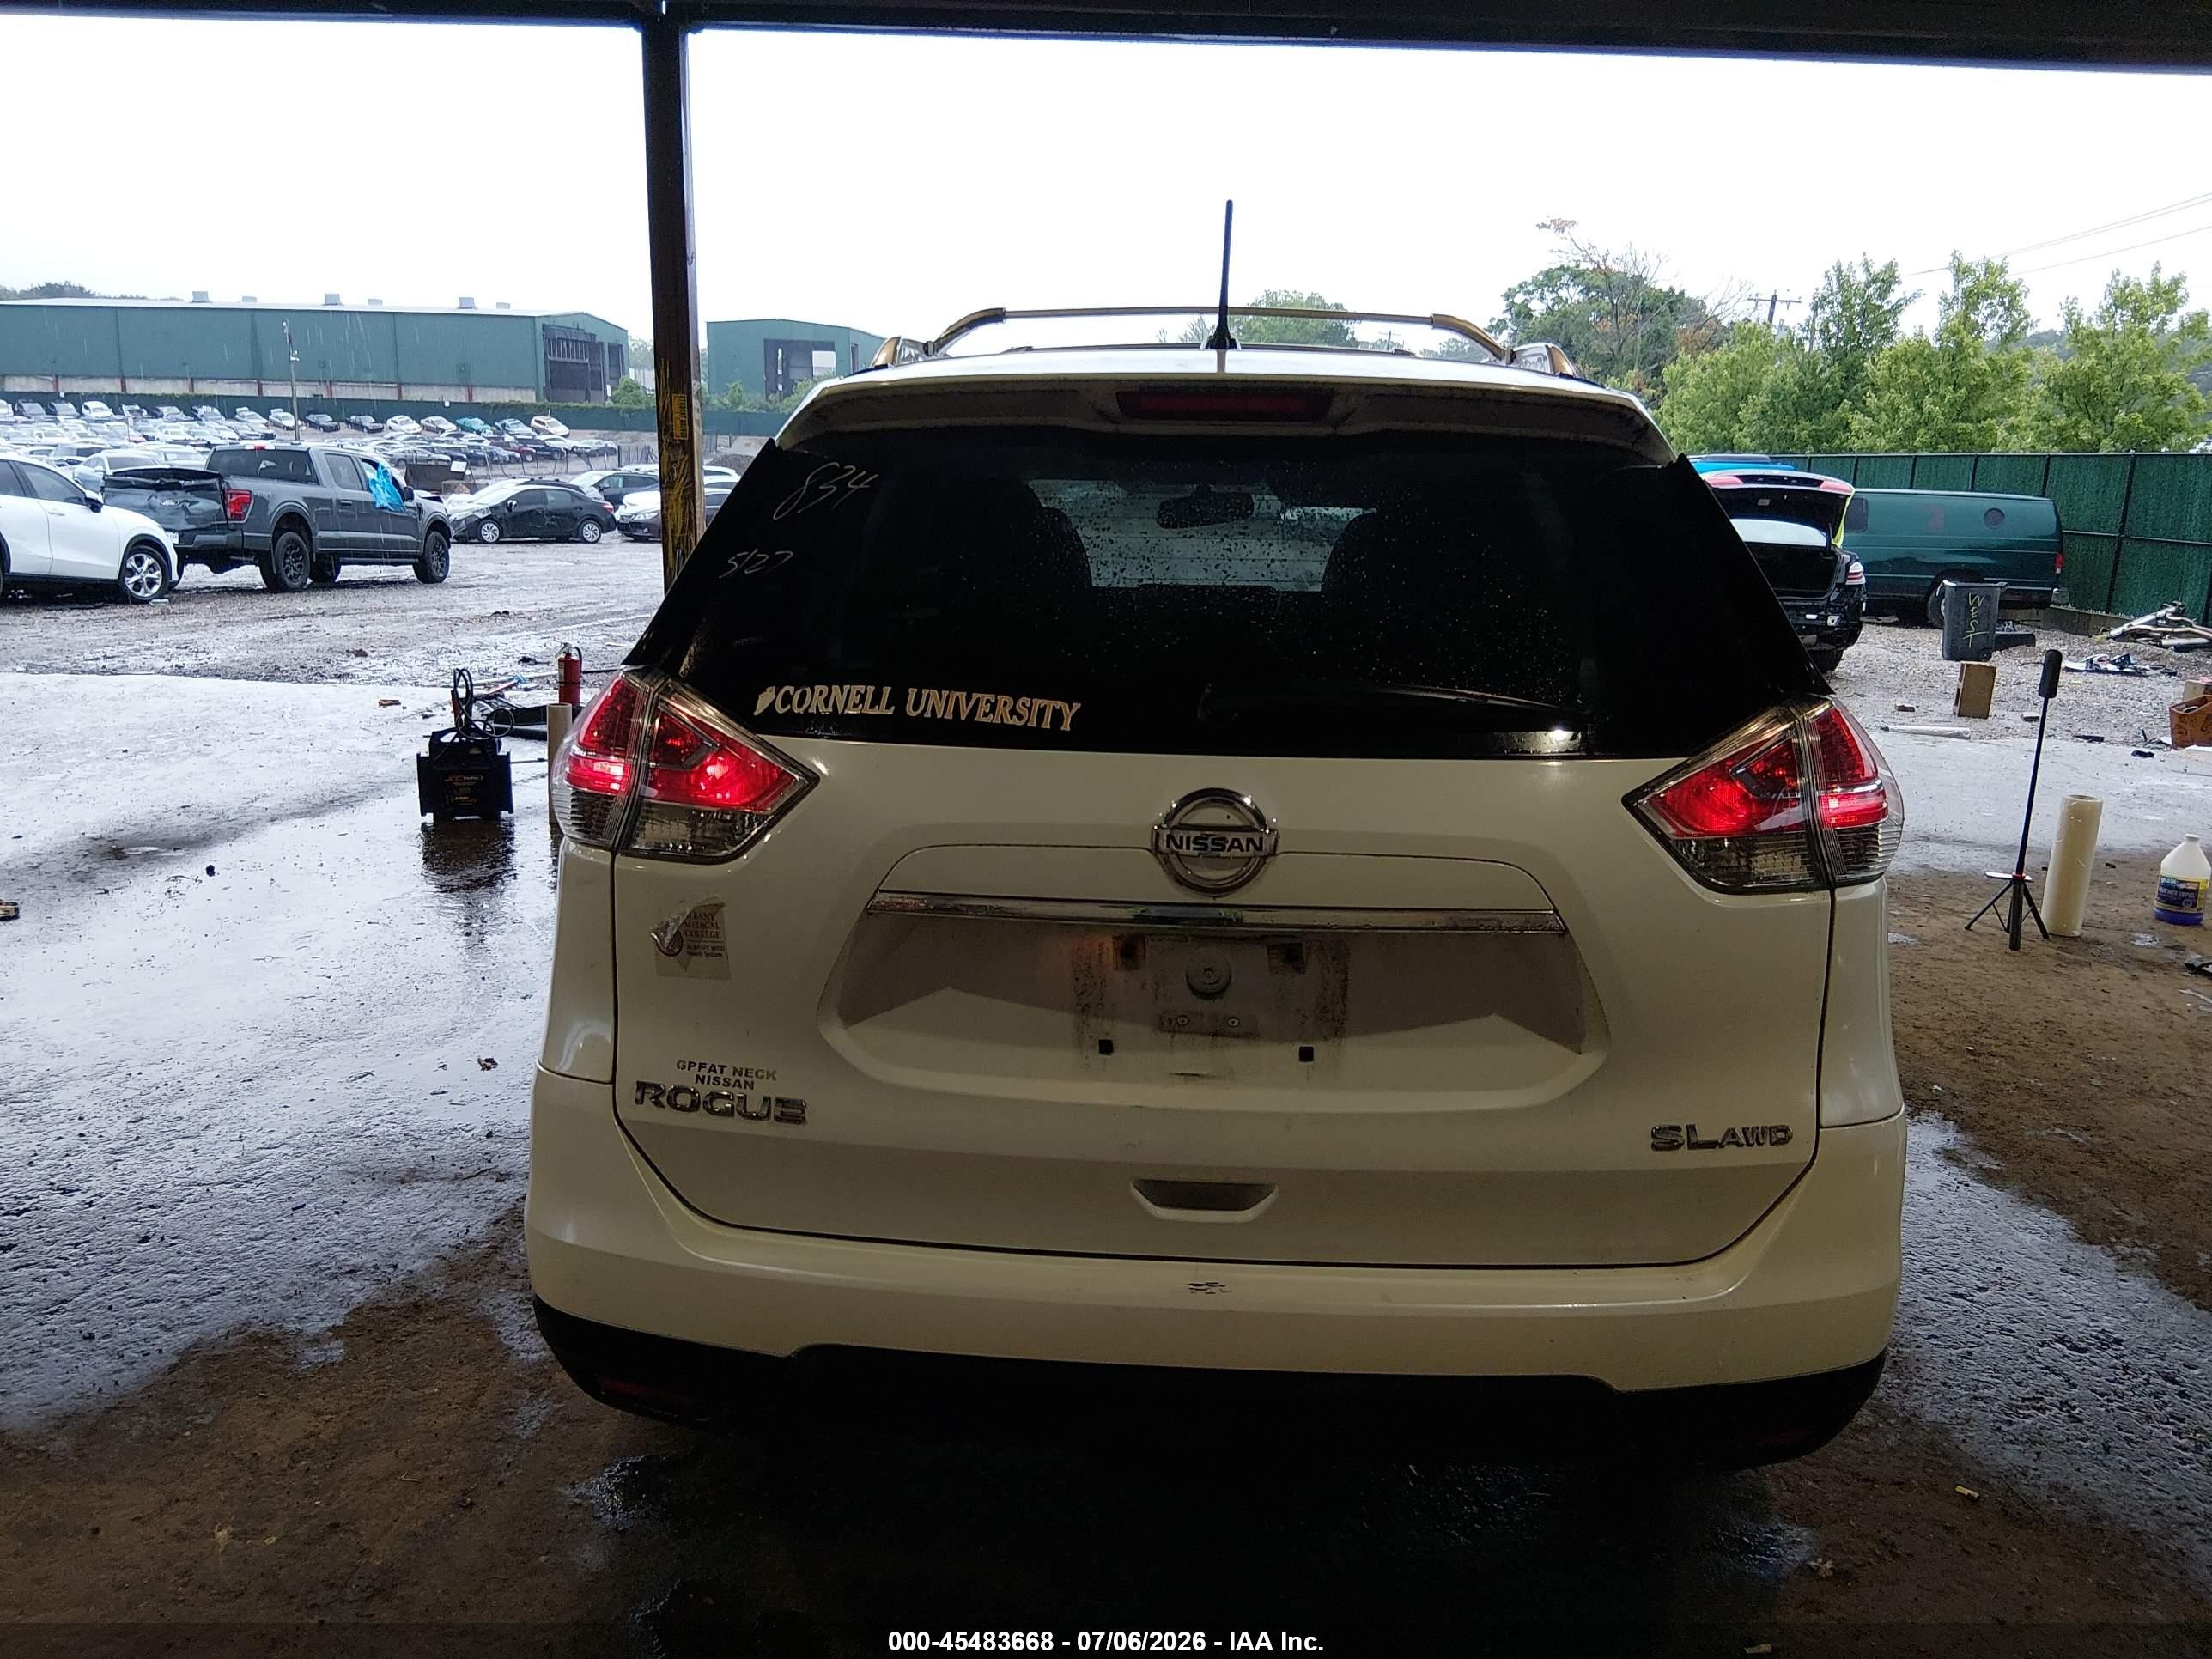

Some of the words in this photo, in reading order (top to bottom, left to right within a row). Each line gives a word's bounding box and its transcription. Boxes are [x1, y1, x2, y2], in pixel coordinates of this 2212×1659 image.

[774, 684, 896, 715] CORNELL
[906, 687, 1081, 732] UNIVERSITY
[1164, 833, 1265, 854] NISSAN
[695, 1073, 755, 1091] NISSAN
[732, 1066, 777, 1081] NECK
[634, 1081, 807, 1125] ROGUE
